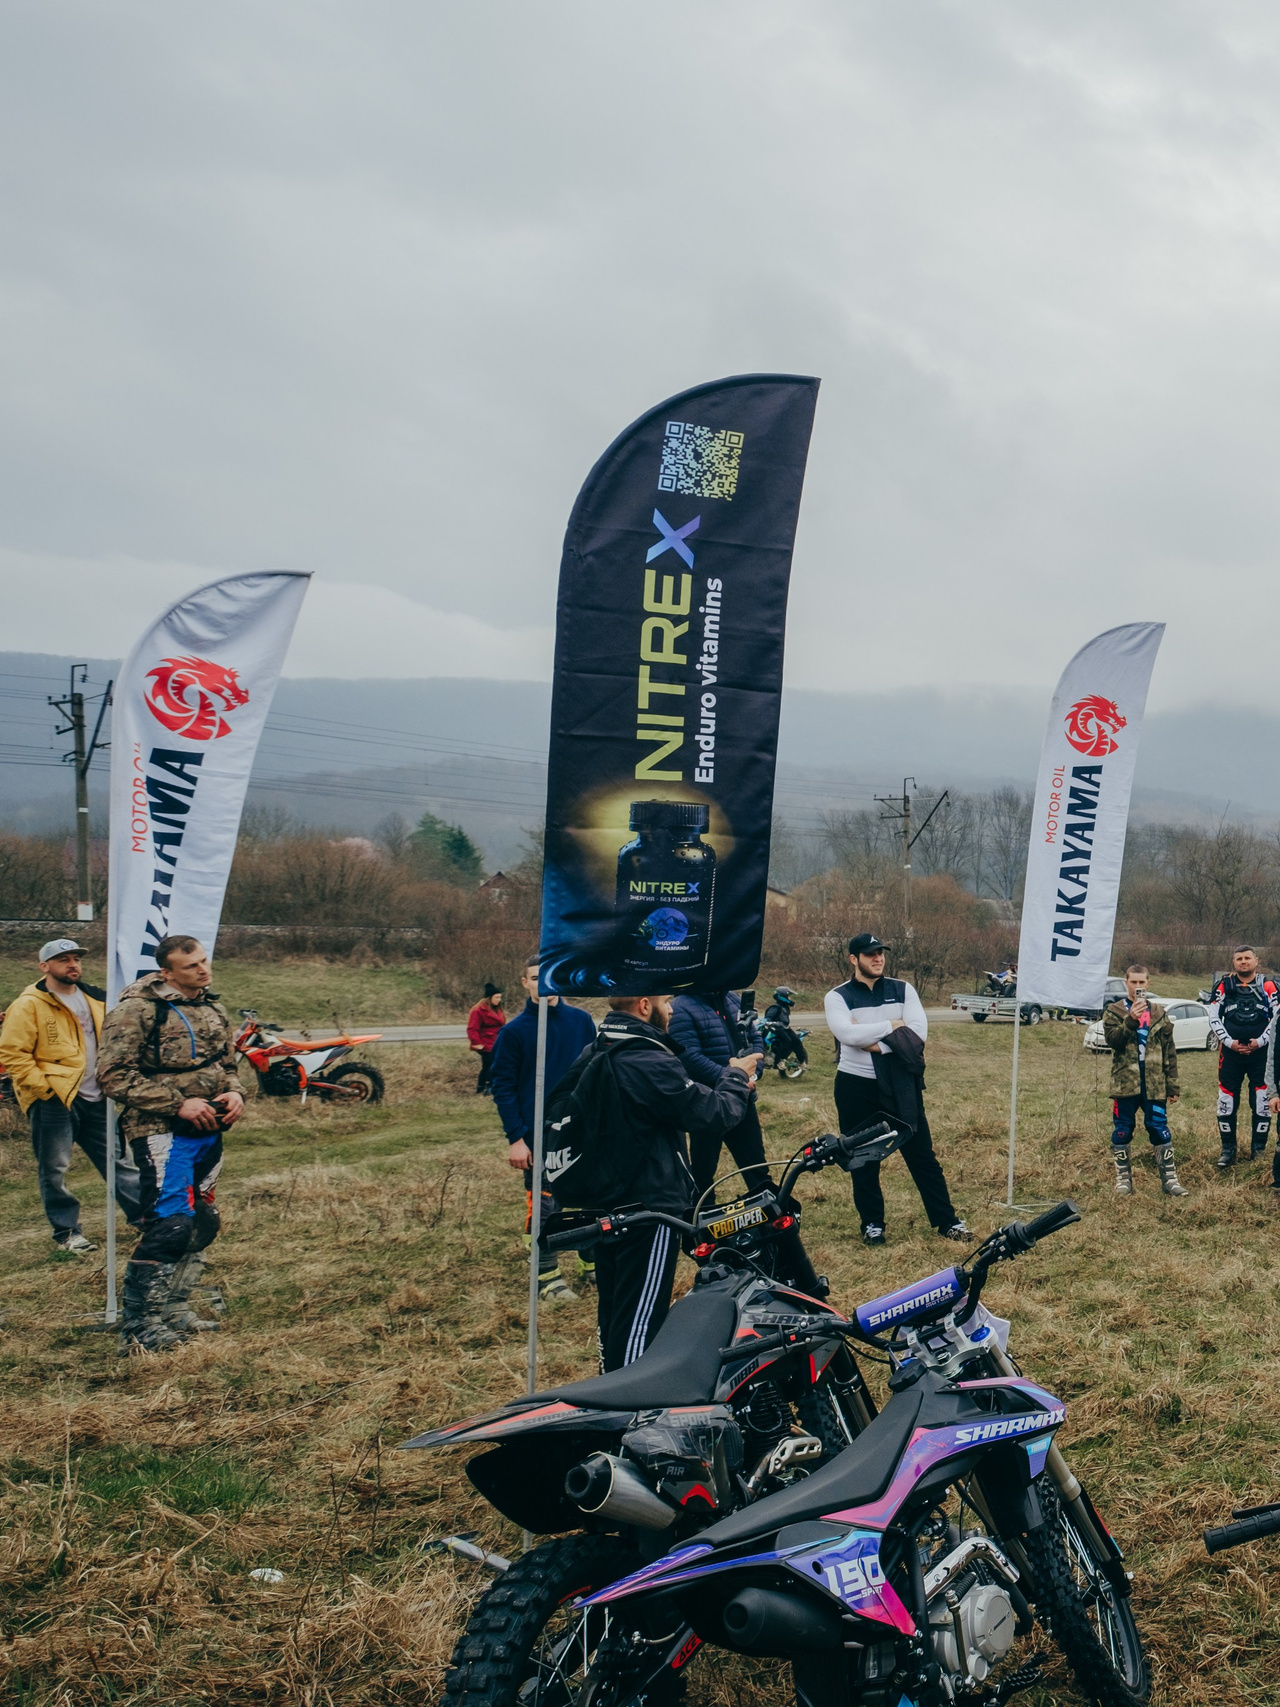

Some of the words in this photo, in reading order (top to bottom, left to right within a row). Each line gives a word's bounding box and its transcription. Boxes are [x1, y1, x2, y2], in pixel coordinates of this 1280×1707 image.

[635, 507, 700, 782] NITREX
[695, 578, 723, 686] vitamins
[694, 693, 717, 783] Enduro
[1052, 764, 1066, 789] OIL
[1045, 791, 1061, 844] MOTOR
[1050, 764, 1104, 962] TAKAYAMA
[629, 880, 700, 894] NITREX
[629, 894, 655, 902] ЭНЕРГИЯ
[712, 1210, 764, 1238] PROTAPER
[867, 1283, 955, 1328] SHARMAX
[925, 1292, 954, 1309] MOTORS
[729, 1358, 759, 1390] NIBBI
[668, 1412, 713, 1428] SPORT
[954, 1408, 1065, 1445] SHARMAX
[666, 1465, 685, 1477] AIR
[824, 1554, 886, 1597] 190
